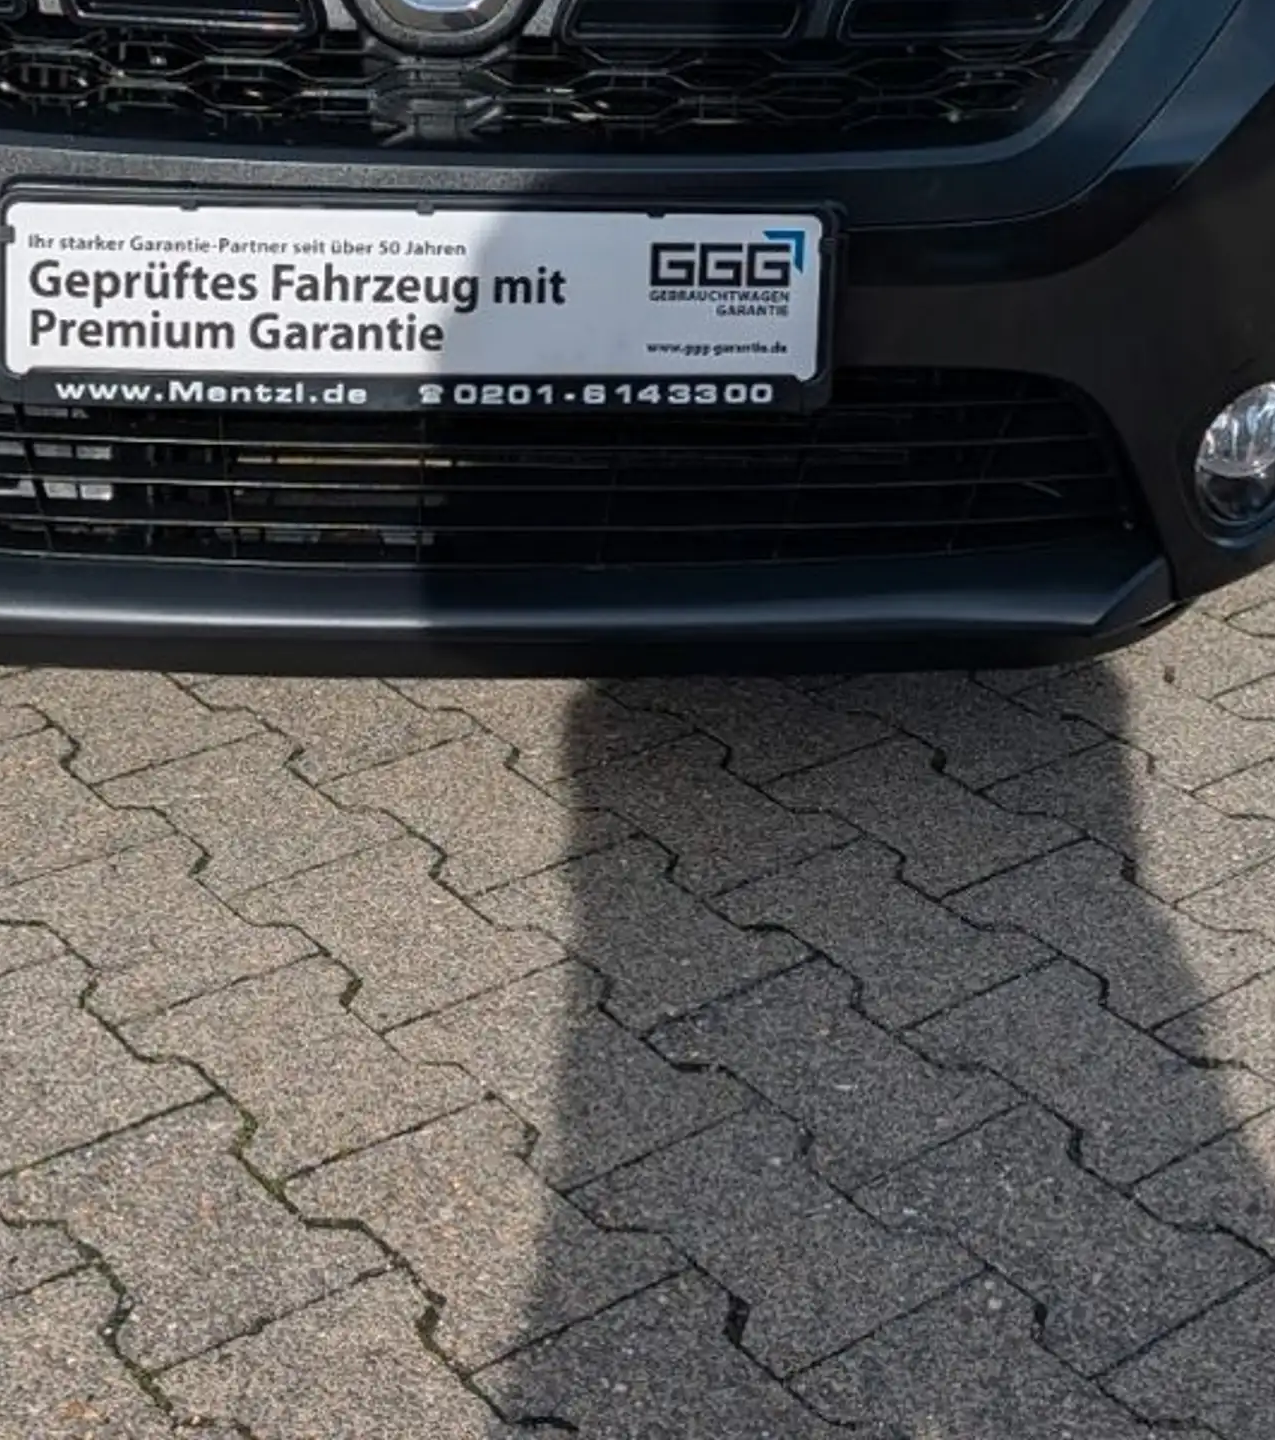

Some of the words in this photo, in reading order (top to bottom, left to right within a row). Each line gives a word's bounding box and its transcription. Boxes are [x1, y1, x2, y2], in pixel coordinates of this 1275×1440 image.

[28, 234, 54, 249] Ihr
[59, 235, 125, 251] starker
[130, 235, 287, 254] Garantie-Partner
[293, 238, 325, 254] seit
[330, 240, 373, 256] über
[378, 240, 401, 255] 50
[405, 241, 466, 257] Jahren
[650, 243, 792, 287] GGG
[29, 259, 258, 309] Geprüftes
[272, 263, 479, 313] Fahrzeug
[493, 266, 567, 305] mit
[649, 290, 791, 303] GEBRAUCHTWAGEN
[715, 305, 790, 317] GARANTIE
[30, 309, 234, 349] Premium
[249, 312, 444, 352] Garantie
[55, 380, 368, 405] www.Mentzl.de
